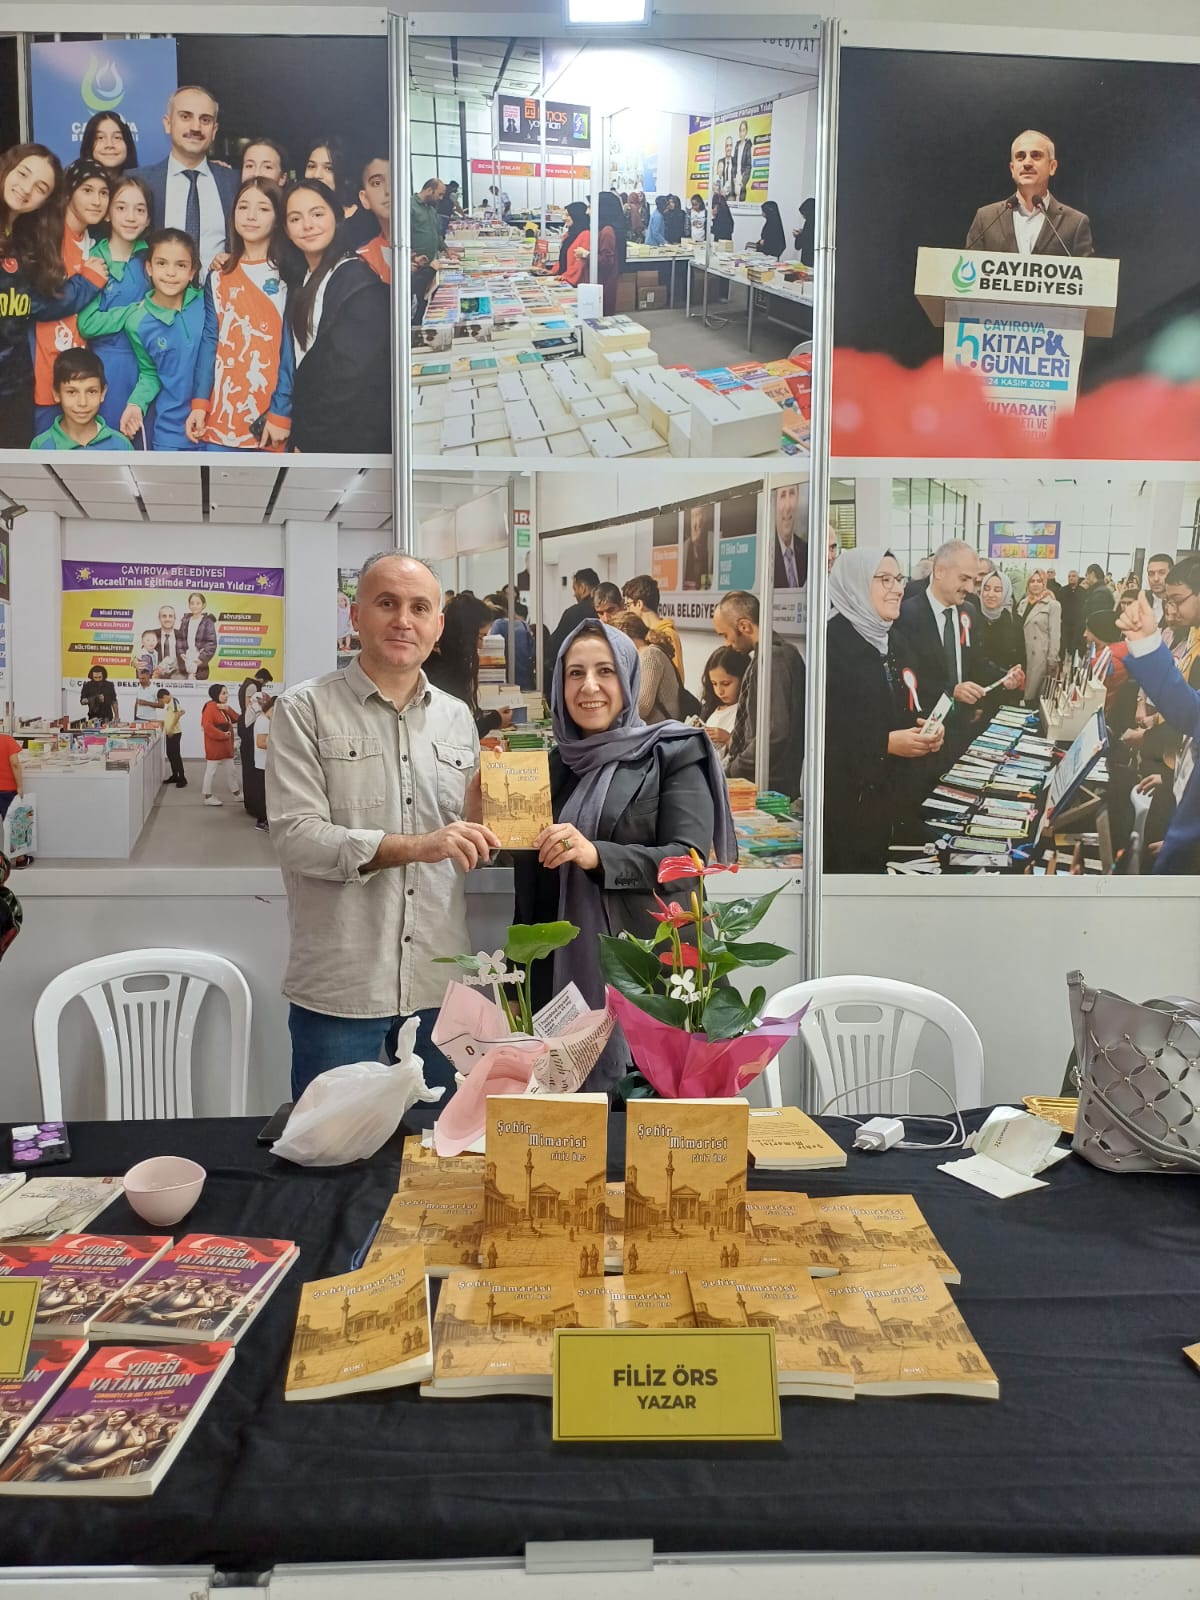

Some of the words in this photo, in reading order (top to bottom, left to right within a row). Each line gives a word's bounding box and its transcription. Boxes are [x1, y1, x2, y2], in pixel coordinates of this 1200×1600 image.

[981, 260, 1083, 280] ÇAYIROVA
[982, 333, 1045, 355] KİTAP
[981, 354, 1070, 378] GÜNLERİ
[1001, 379, 1027, 387] KASIM
[1030, 381, 1050, 389] 2024
[121, 565, 168, 576] ÇAYIROVA
[171, 567, 226, 577] BELEDİYESİ
[92, 577, 142, 586] Kocaeli'nin
[144, 578, 184, 588] Eğitimde
[186, 579, 225, 590] Parlayan
[227, 581, 255, 591] Yıldızı
[497, 1120, 532, 1136] Şehir
[637, 1123, 673, 1140] Şehir
[528, 1132, 587, 1149] Mimarisi
[669, 1135, 728, 1150] Mimarisi
[49, 1254, 94, 1265] VATAN
[94, 1256, 136, 1267] KADIN
[174, 1254, 220, 1266] VATAN
[217, 1257, 260, 1270] KADIN
[88, 1376, 147, 1392] VATAN
[144, 1373, 195, 1390] KADIN
[613, 1363, 667, 1387] FİLİZ
[672, 1363, 719, 1387] ÖRS
[636, 1394, 697, 1410] YAZAR
